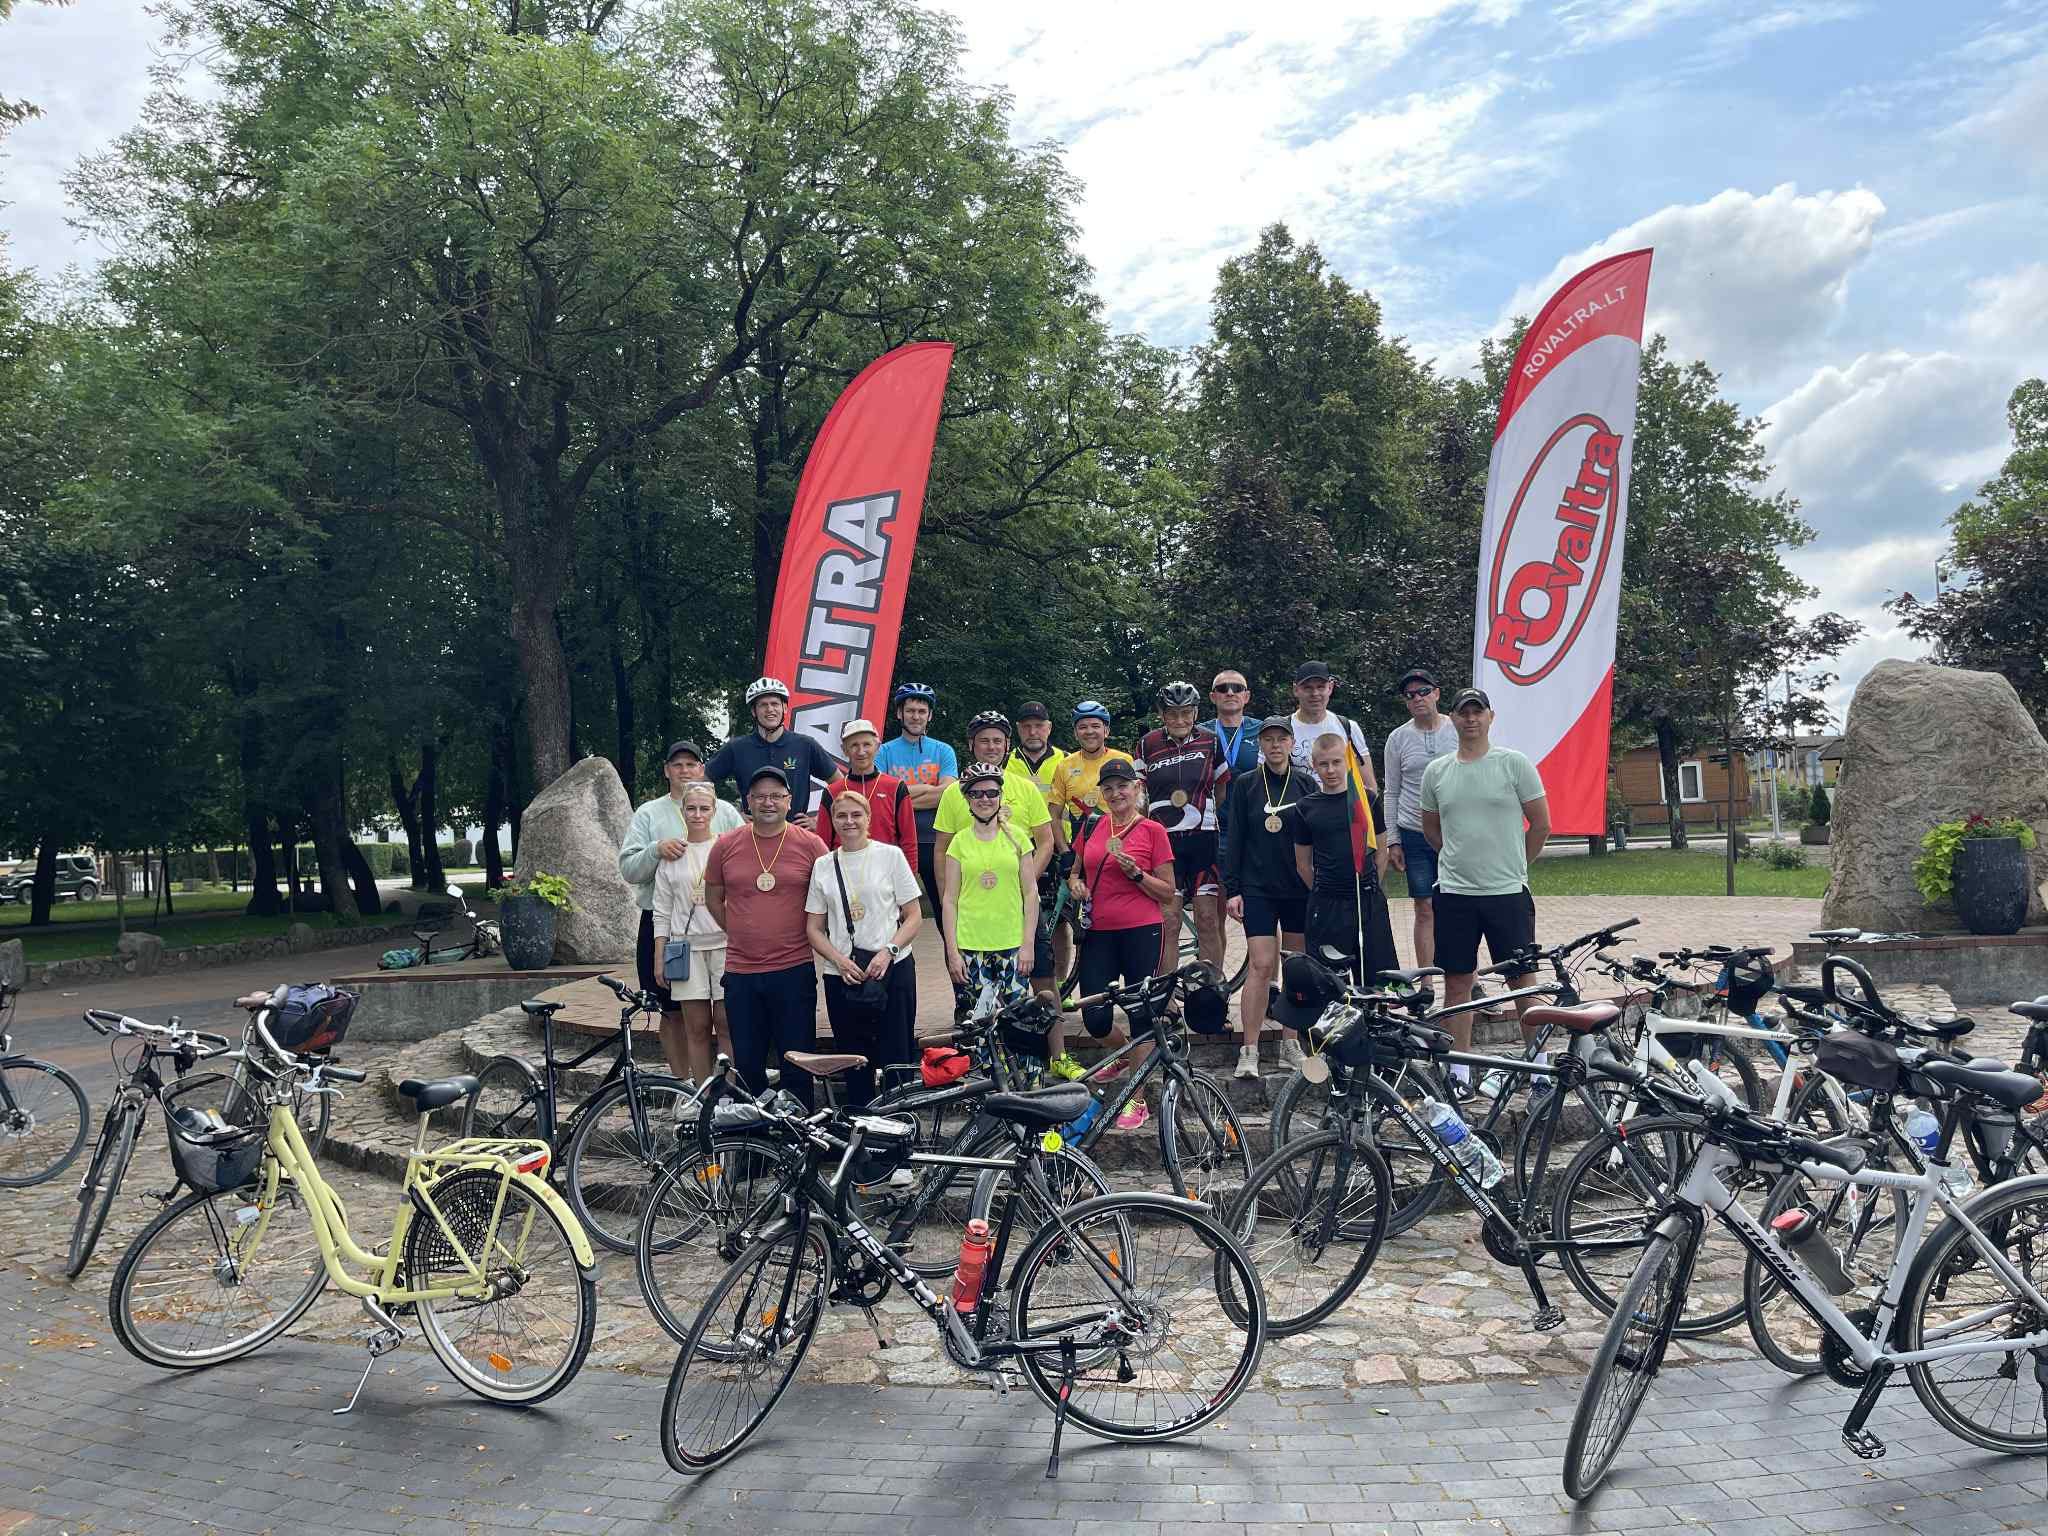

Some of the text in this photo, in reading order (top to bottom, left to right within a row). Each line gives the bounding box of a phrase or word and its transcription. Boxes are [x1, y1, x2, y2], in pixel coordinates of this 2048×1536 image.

[1522, 285, 1629, 379] ROVALTRA.LT
[790, 489, 901, 800] ALTRA
[1147, 751, 1206, 773] ORBEA
[1736, 1220, 1801, 1281] STEVENS
